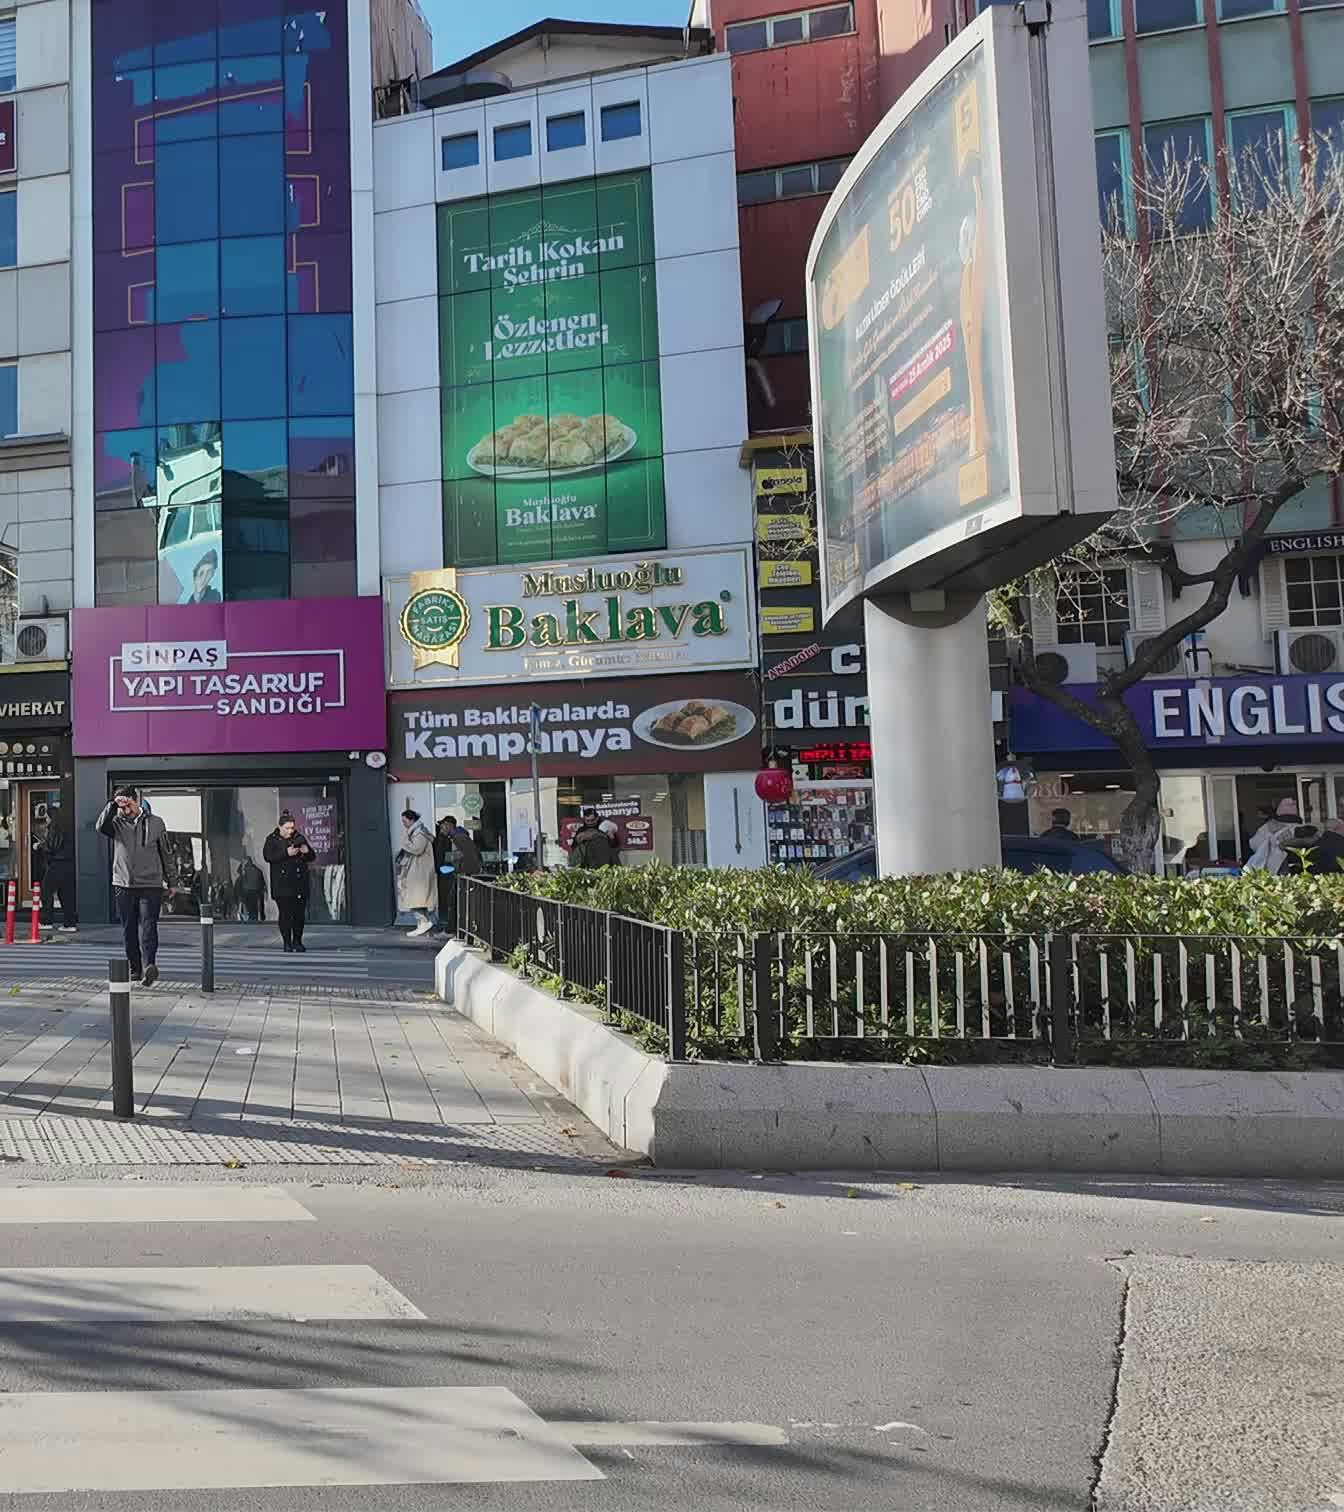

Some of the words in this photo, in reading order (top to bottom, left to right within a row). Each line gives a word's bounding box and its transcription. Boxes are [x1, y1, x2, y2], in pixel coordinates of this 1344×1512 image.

[464, 246, 532, 273] Tarih
[539, 235, 624, 263] Kokan
[503, 260, 585, 293] Şehrin
[494, 312, 597, 340] Özlenen
[484, 324, 609, 361] Lezzetleri
[504, 503, 598, 527] Baklava
[1271, 535, 1344, 552] ENGLISH
[520, 562, 684, 598] Musluoğlu
[484, 596, 729, 652] Baklava
[130, 644, 219, 666] SİNPAŞ
[122, 675, 183, 696] YAPI
[190, 671, 325, 695] TASARRUF
[216, 694, 322, 716] SANDIĞI
[404, 709, 458, 729] Tüm
